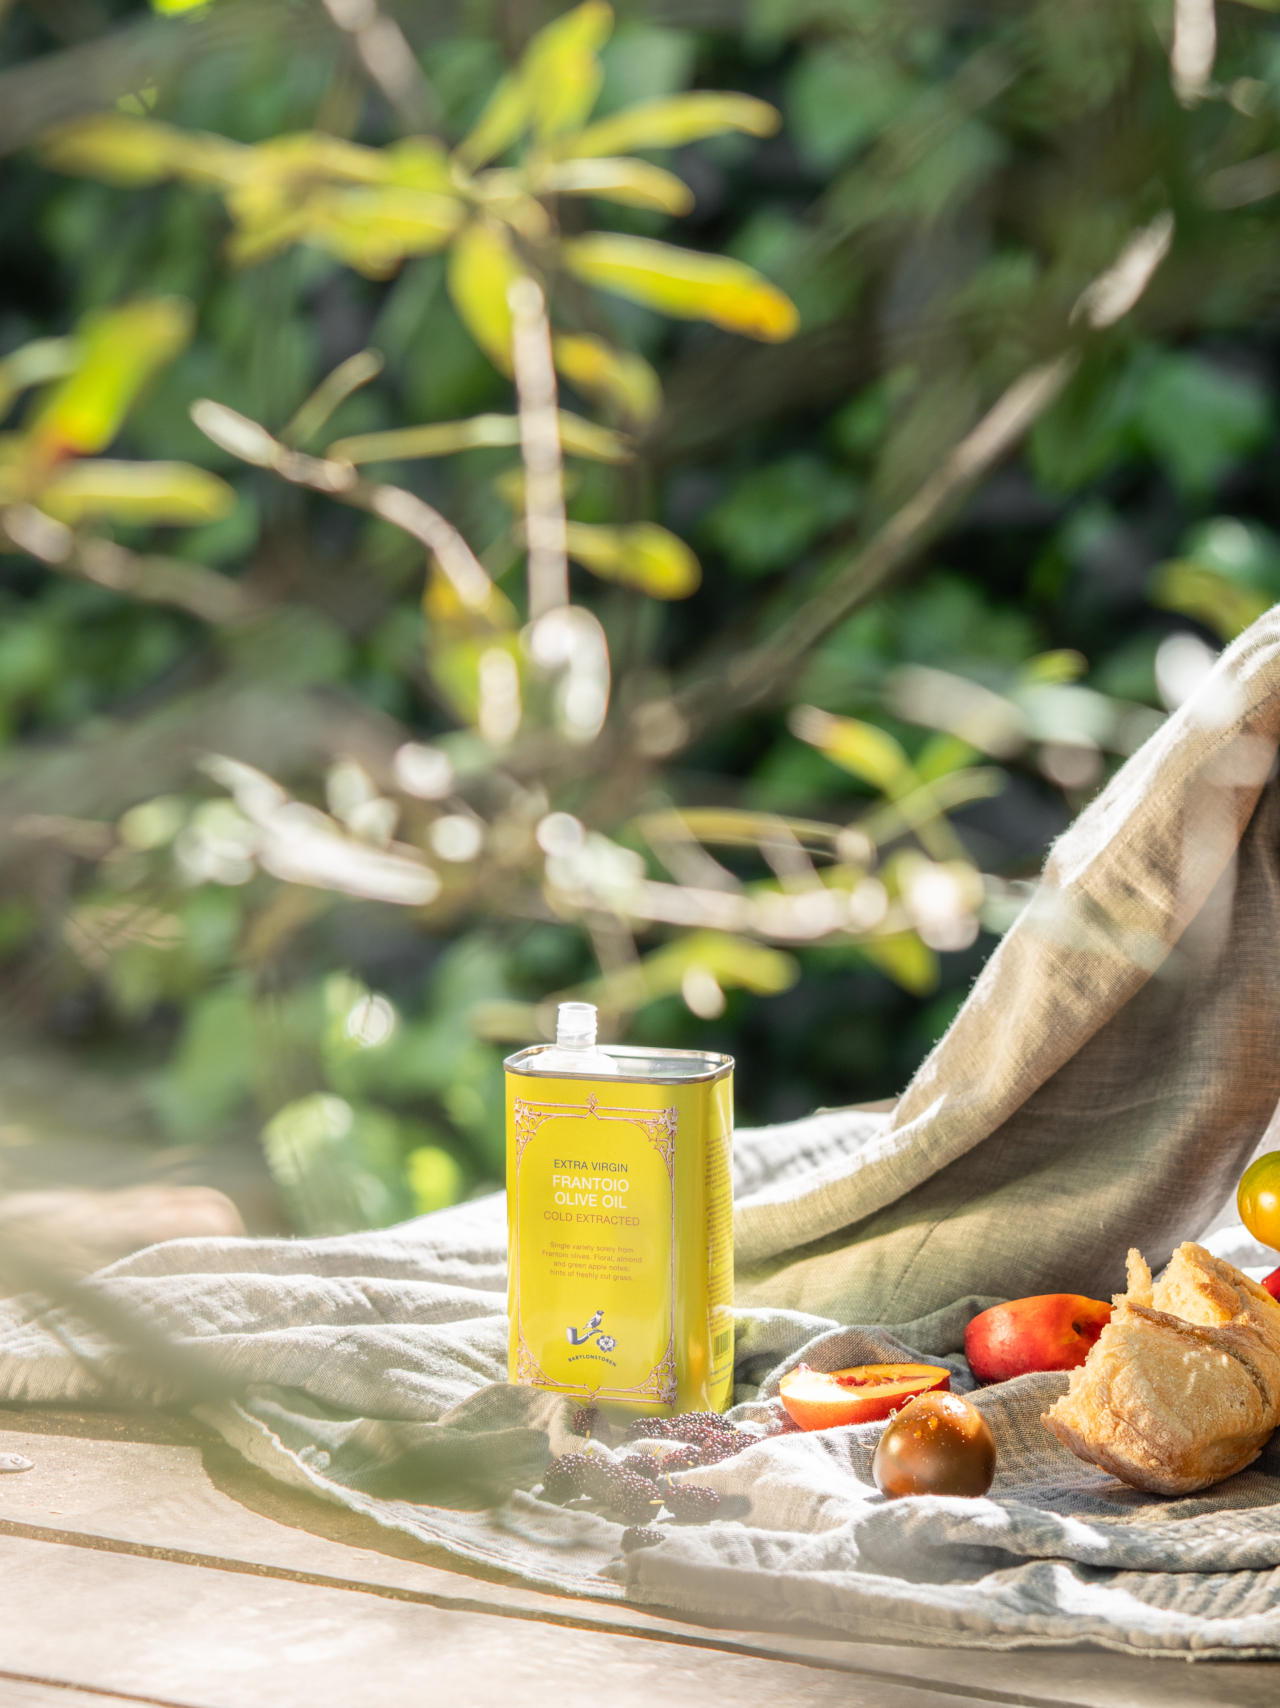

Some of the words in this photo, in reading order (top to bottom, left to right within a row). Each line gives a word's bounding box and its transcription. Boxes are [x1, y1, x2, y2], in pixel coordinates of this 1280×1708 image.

[554, 1159, 588, 1170] EXTRA
[591, 1162, 628, 1172] VIRGIN
[552, 1174, 629, 1192] FRANTOIO
[554, 1192, 598, 1207] OLIVE
[602, 1194, 628, 1208] OIL
[544, 1210, 572, 1222] COLD
[576, 1213, 640, 1226] EXTRACTED
[550, 1241, 570, 1250] Single
[572, 1243, 594, 1252] variety
[596, 1246, 616, 1254] solely
[542, 1250, 568, 1258] Frantoio
[570, 1252, 592, 1260] olives.
[594, 1254, 614, 1262] Floral,
[576, 1271, 598, 1280] freshly
[568, 1354, 617, 1367] BABYLONSTOREN
